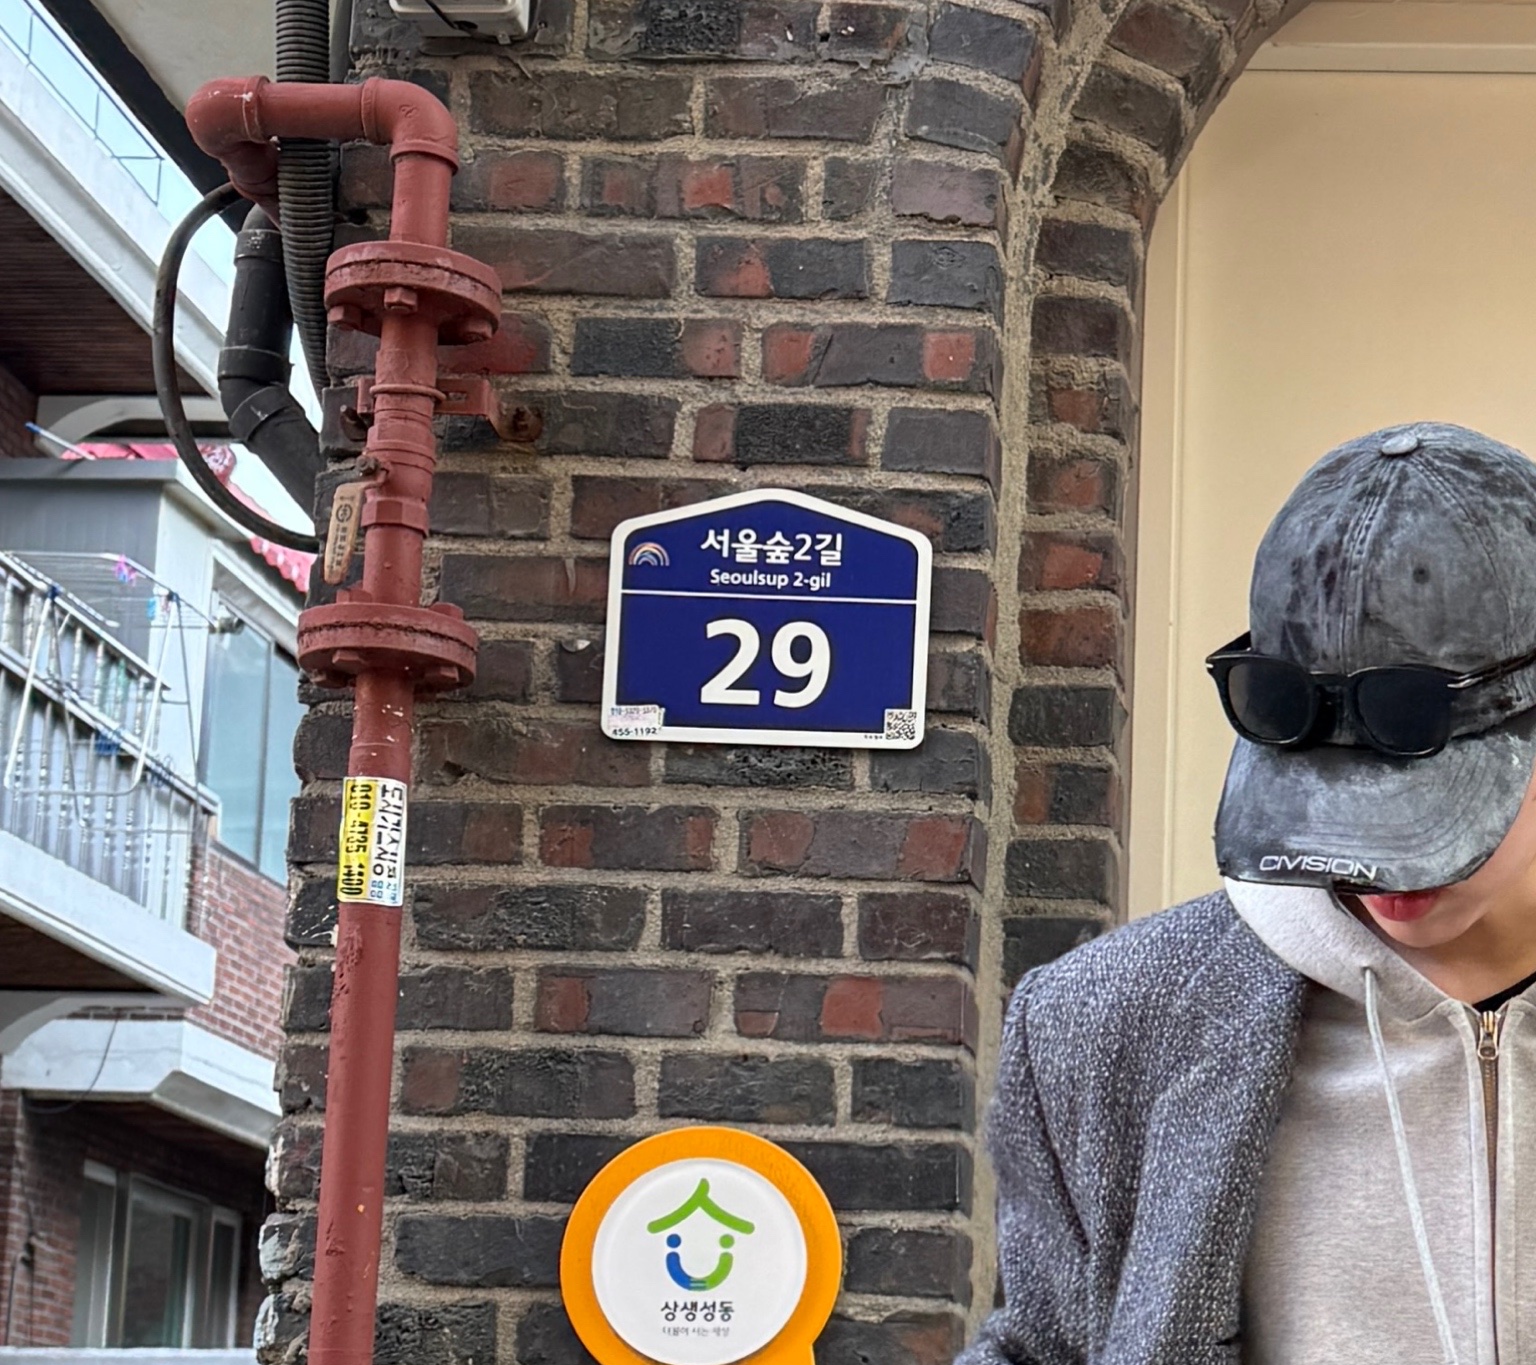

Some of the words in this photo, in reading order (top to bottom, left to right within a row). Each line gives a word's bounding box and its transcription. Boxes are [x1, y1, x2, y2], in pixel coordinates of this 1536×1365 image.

[700, 528, 843, 567] 서울숲2길
[710, 568, 790, 590] Seoulsup
[793, 571, 831, 592] 2-gil
[700, 618, 832, 709] 29
[1259, 855, 1378, 881] CIVISION
[660, 1300, 735, 1322] 상생성동
